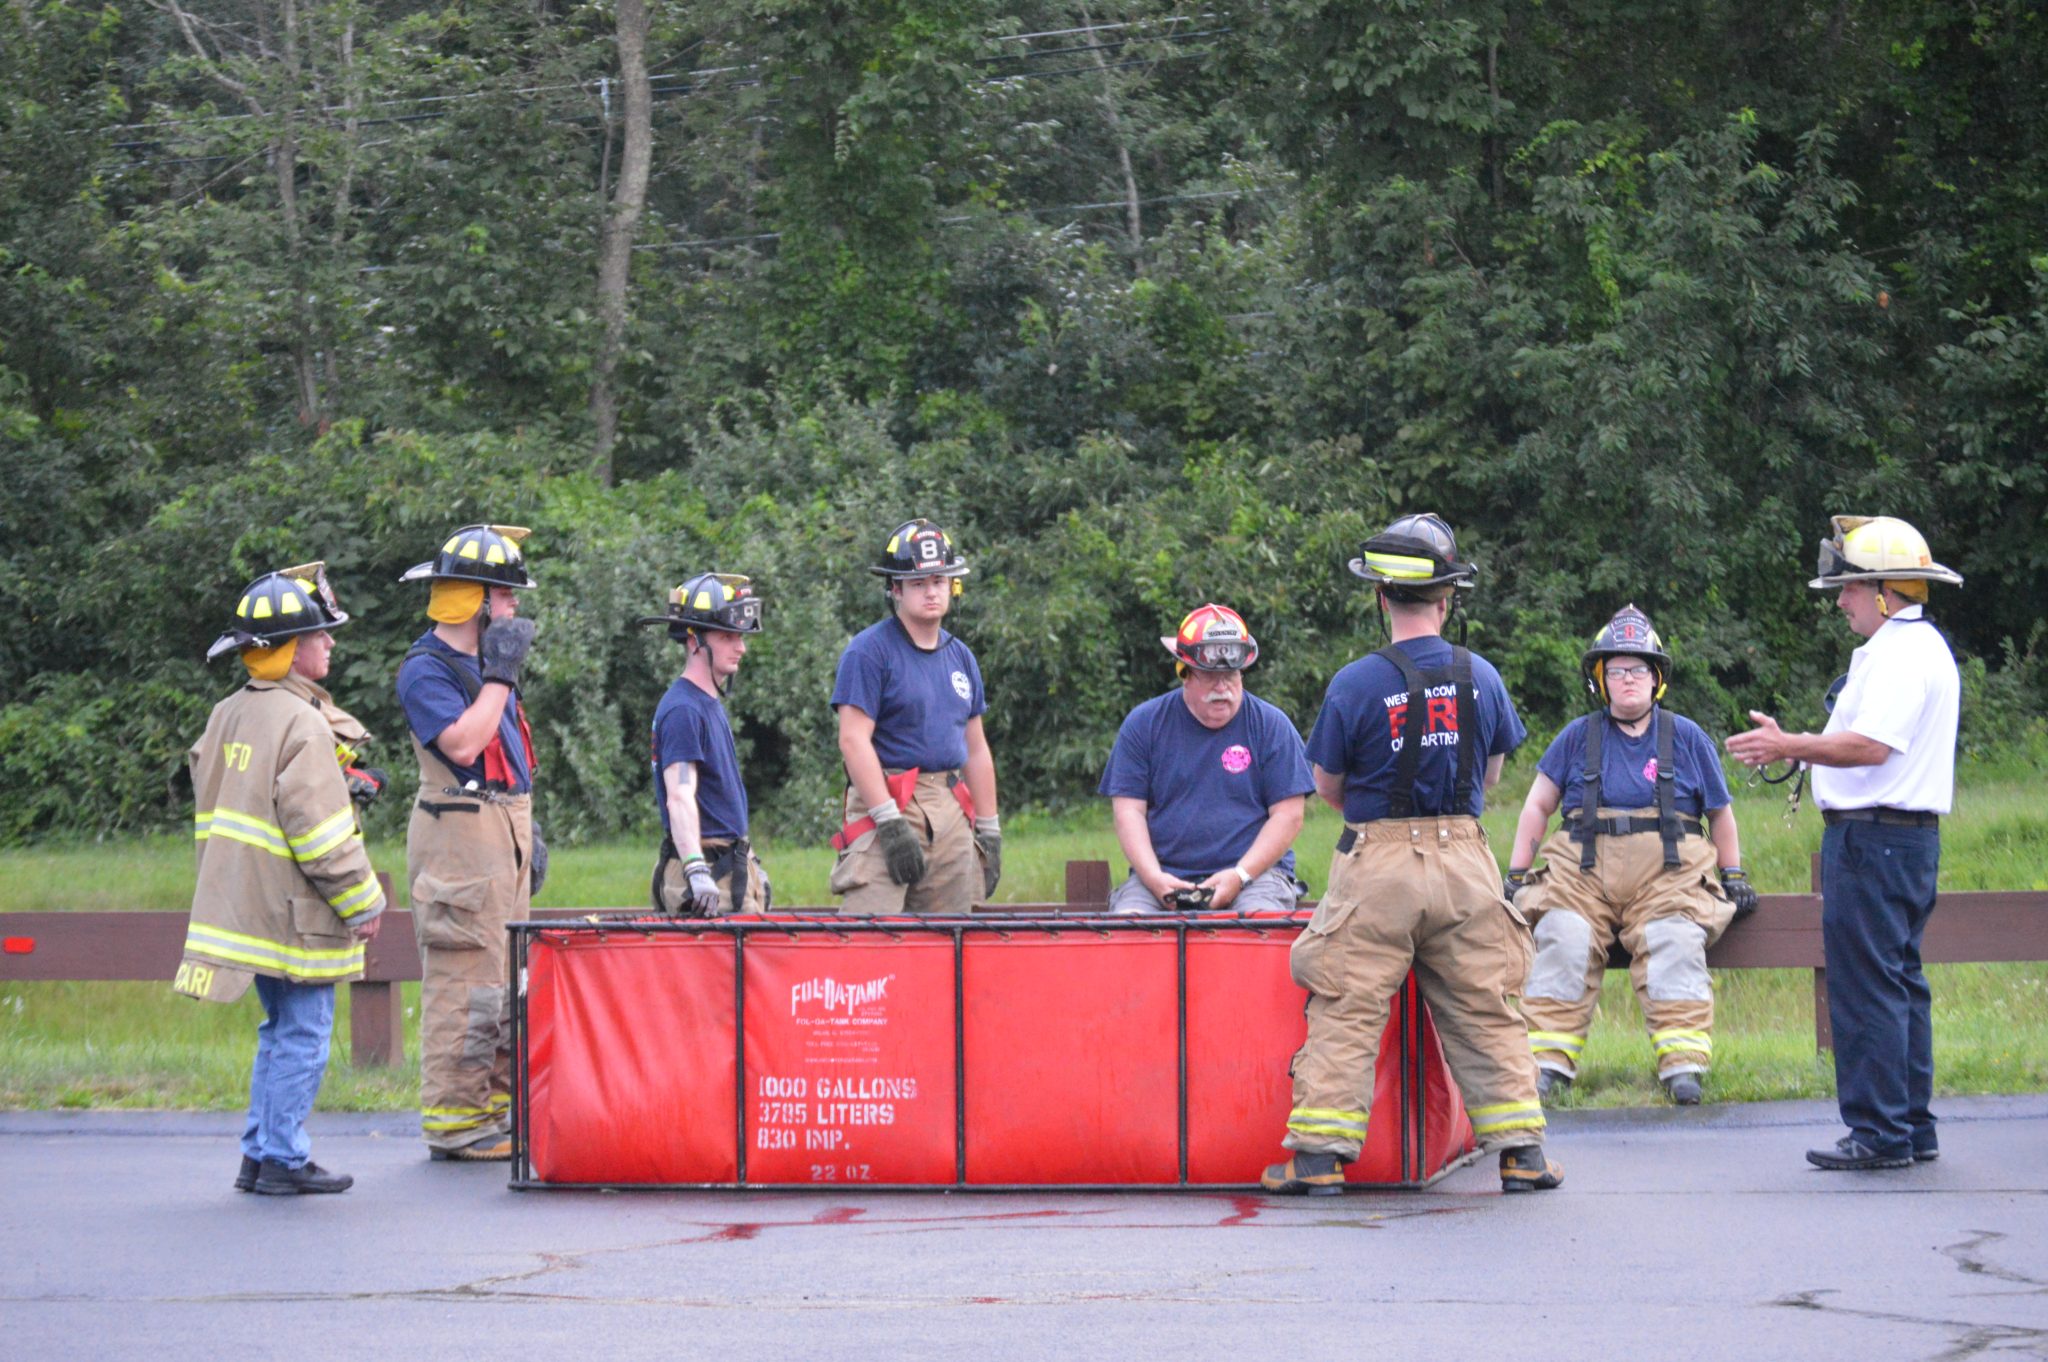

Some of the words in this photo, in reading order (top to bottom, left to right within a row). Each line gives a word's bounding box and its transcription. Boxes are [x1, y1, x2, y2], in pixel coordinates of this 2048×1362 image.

[921, 540, 938, 559] 8
[852, 1017, 888, 1026] COMPANY
[758, 1076, 807, 1098] 1000
[816, 1077, 917, 1099] GALLONS
[758, 1102, 807, 1125] 3785
[817, 1103, 894, 1125] LITERS
[757, 1127, 796, 1149] 830
[806, 1128, 850, 1150] IMP.
[811, 1164, 836, 1181] 22
